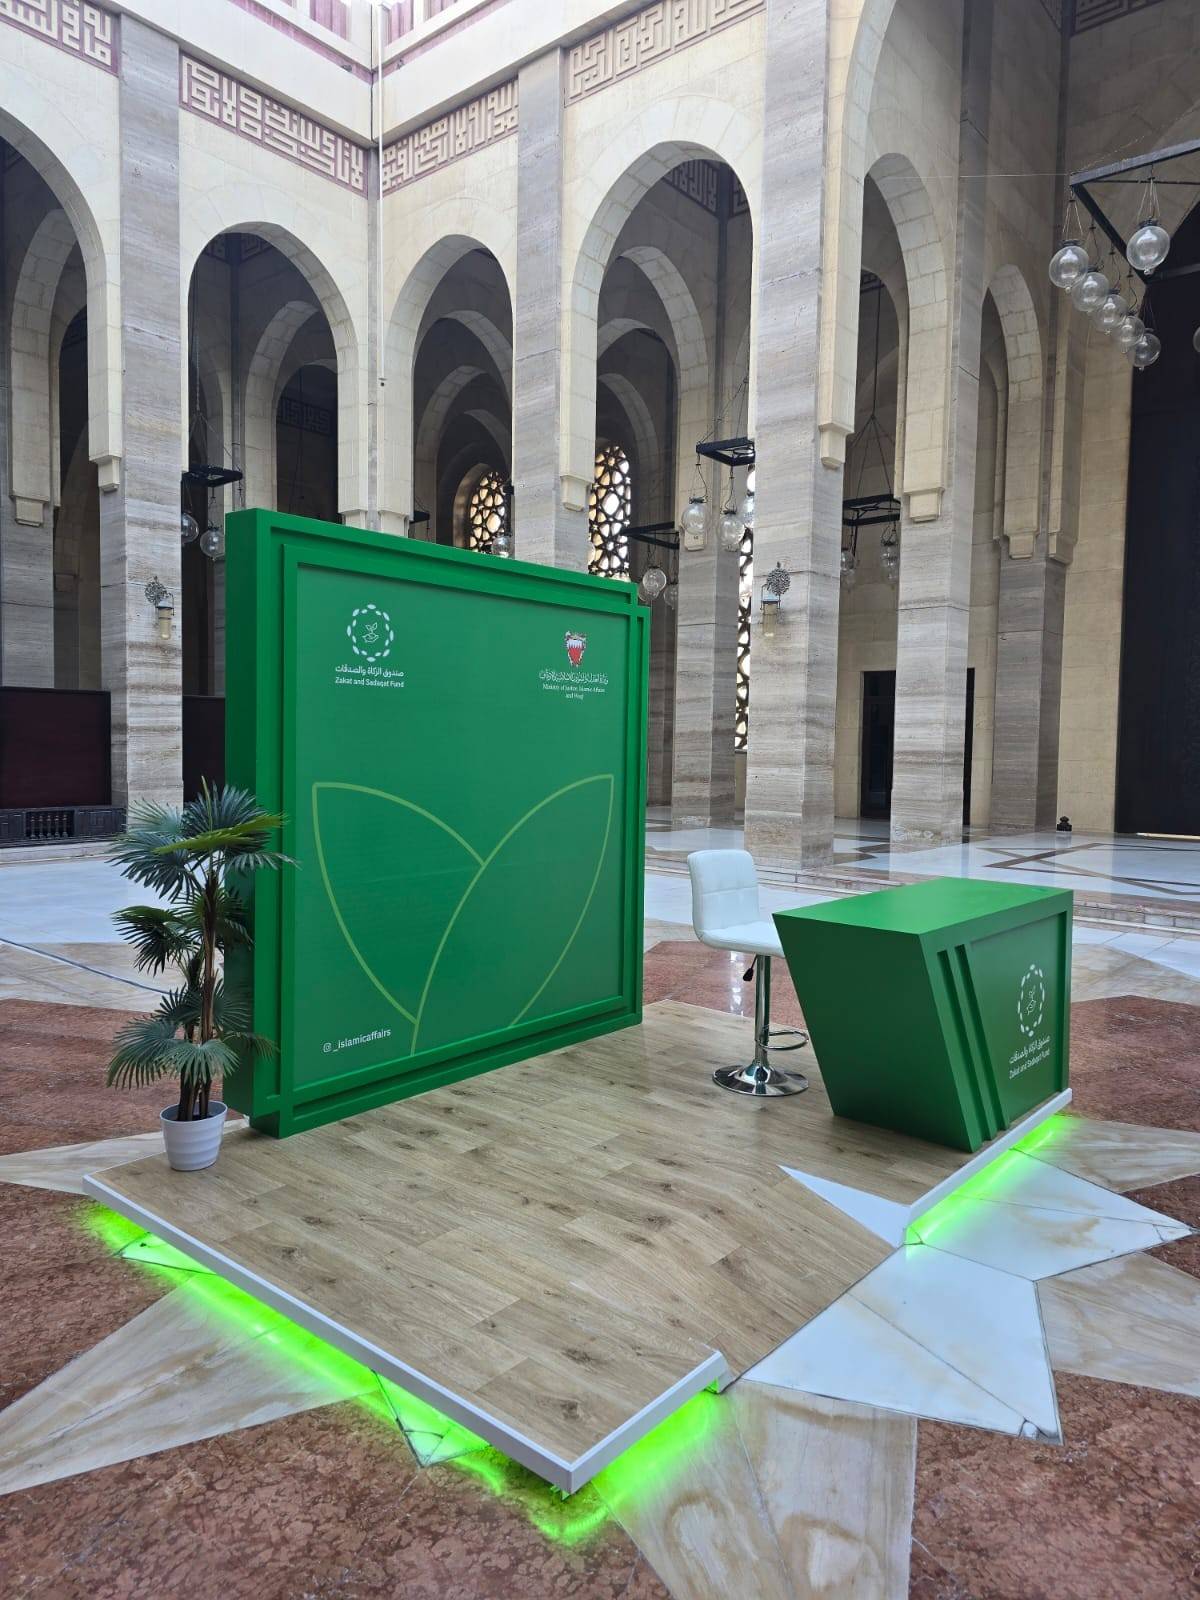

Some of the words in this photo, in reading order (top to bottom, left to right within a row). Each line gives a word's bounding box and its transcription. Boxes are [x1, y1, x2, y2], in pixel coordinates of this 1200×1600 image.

[382, 669, 404, 677] صندوق
[335, 676, 353, 685] Zakat
[353, 678, 365, 686] and
[390, 680, 404, 688] Fund
